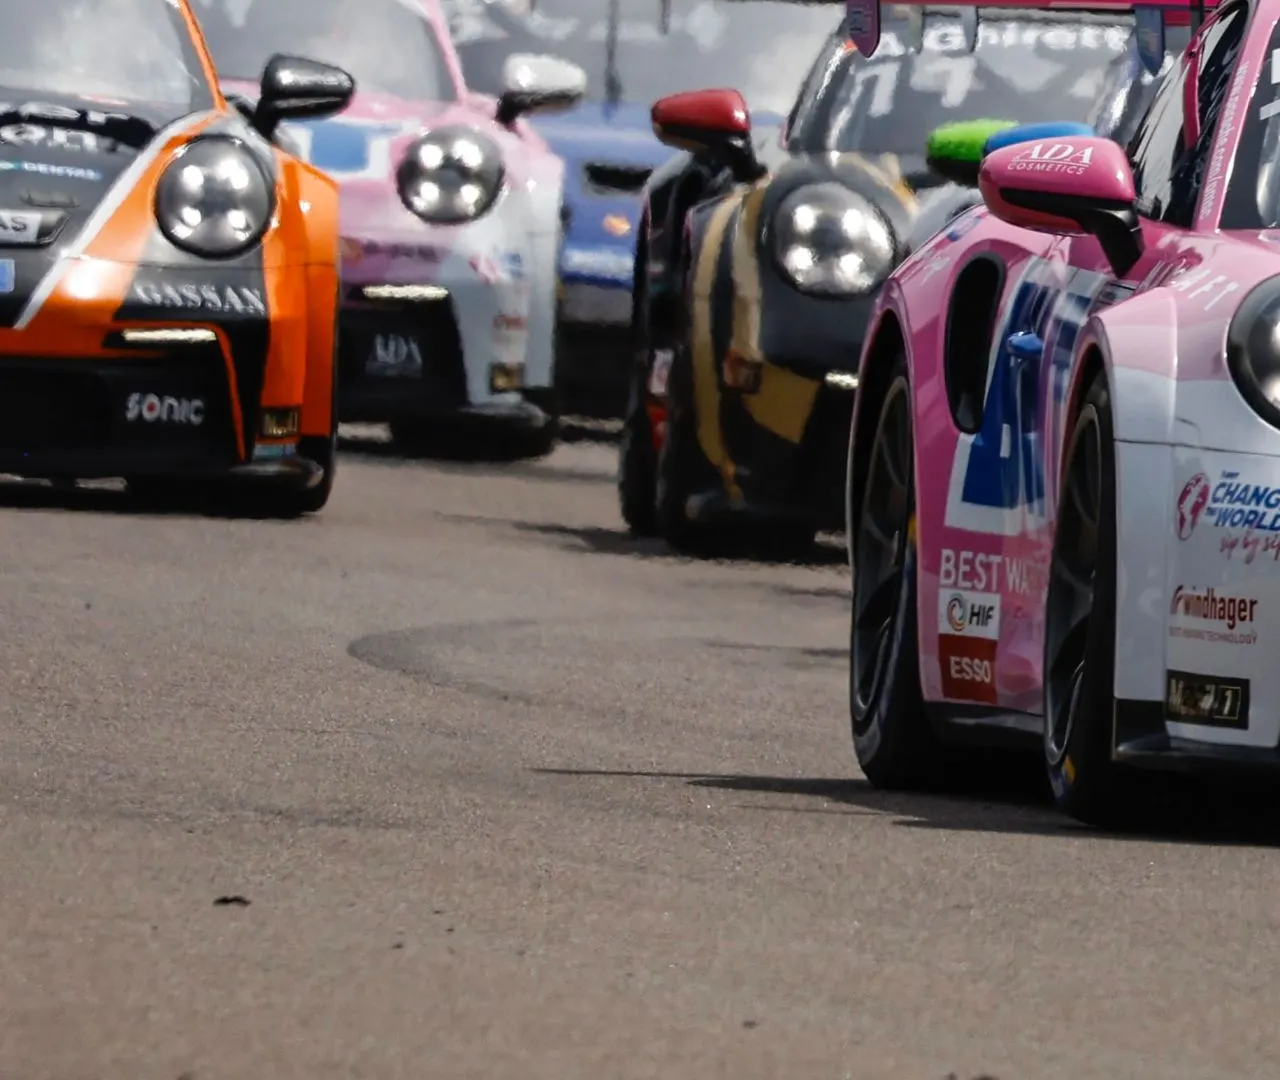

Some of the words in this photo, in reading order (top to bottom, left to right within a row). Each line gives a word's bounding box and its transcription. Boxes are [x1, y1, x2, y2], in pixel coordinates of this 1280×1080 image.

[1011, 143, 1094, 165] ADA
[1007, 161, 1086, 176] COSMETICS
[940, 548, 1002, 591] BEST
[969, 603, 994, 627] HIF
[950, 656, 992, 684] ESSO
